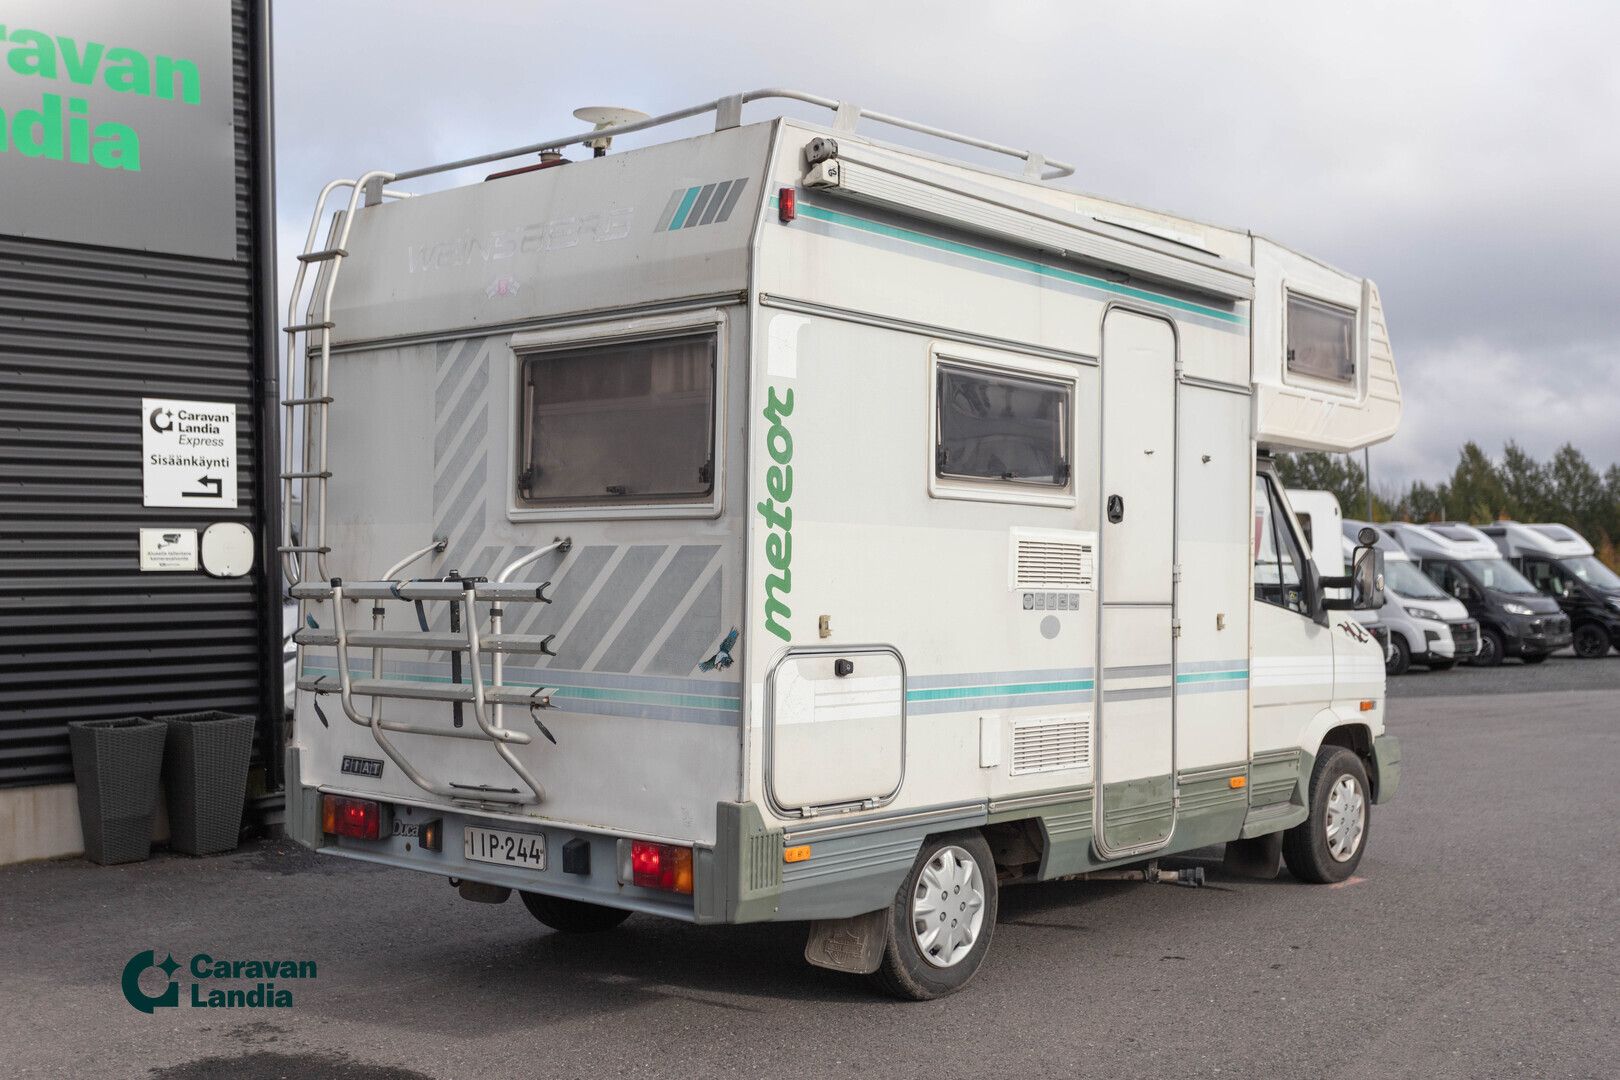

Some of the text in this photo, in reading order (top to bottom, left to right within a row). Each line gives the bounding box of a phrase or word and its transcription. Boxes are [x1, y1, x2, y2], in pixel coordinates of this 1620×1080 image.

[0, 24, 201, 106] avan
[0, 92, 142, 172] dia
[177, 409, 230, 423] Caravan
[178, 422, 220, 434] Landia
[178, 434, 225, 448] Express
[150, 454, 230, 470] Sisäänkäynti
[756, 385, 795, 643] meteor
[343, 758, 381, 776] FIAT
[470, 831, 541, 865] IIP-244
